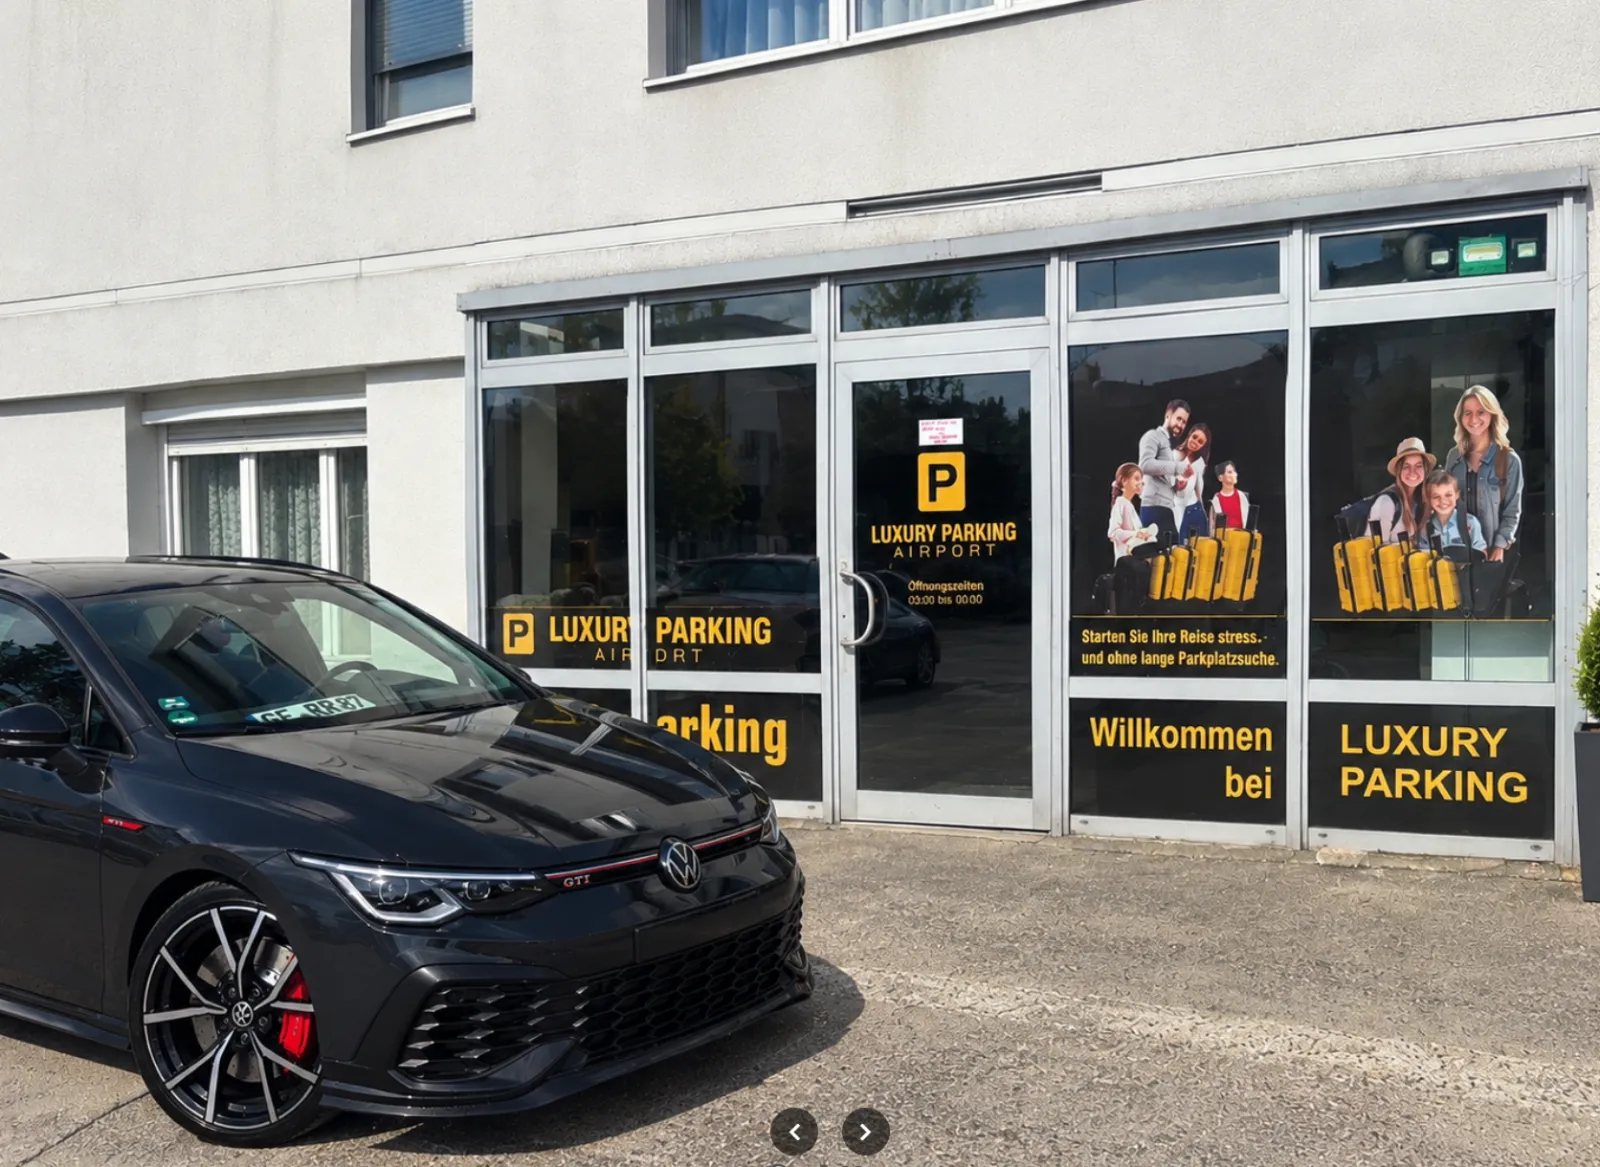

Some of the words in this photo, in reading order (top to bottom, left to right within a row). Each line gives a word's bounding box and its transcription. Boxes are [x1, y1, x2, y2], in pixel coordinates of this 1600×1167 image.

[928, 464, 957, 502] P
[871, 523, 937, 544] LUXURY
[941, 521, 1017, 543] PARKING
[893, 543, 996, 558] AIRPORT
[509, 619, 529, 648] P
[549, 615, 631, 643] LUXUR
[656, 616, 772, 646] PARKING
[1081, 629, 1126, 644] Starten
[1129, 628, 1149, 644] Sie
[1152, 629, 1177, 644] Ihre
[1180, 629, 1215, 644] Reise
[1081, 650, 1104, 665] und
[1107, 651, 1138, 665] ohne
[1141, 651, 1175, 668] lange
[1178, 651, 1280, 668] Parkplatzsuche.
[1089, 716, 1274, 753] Willkommen
[1340, 723, 1508, 759] LUXURY
[1224, 765, 1273, 800] bei
[1340, 765, 1529, 804] PARKING
[563, 874, 591, 888] GTI
